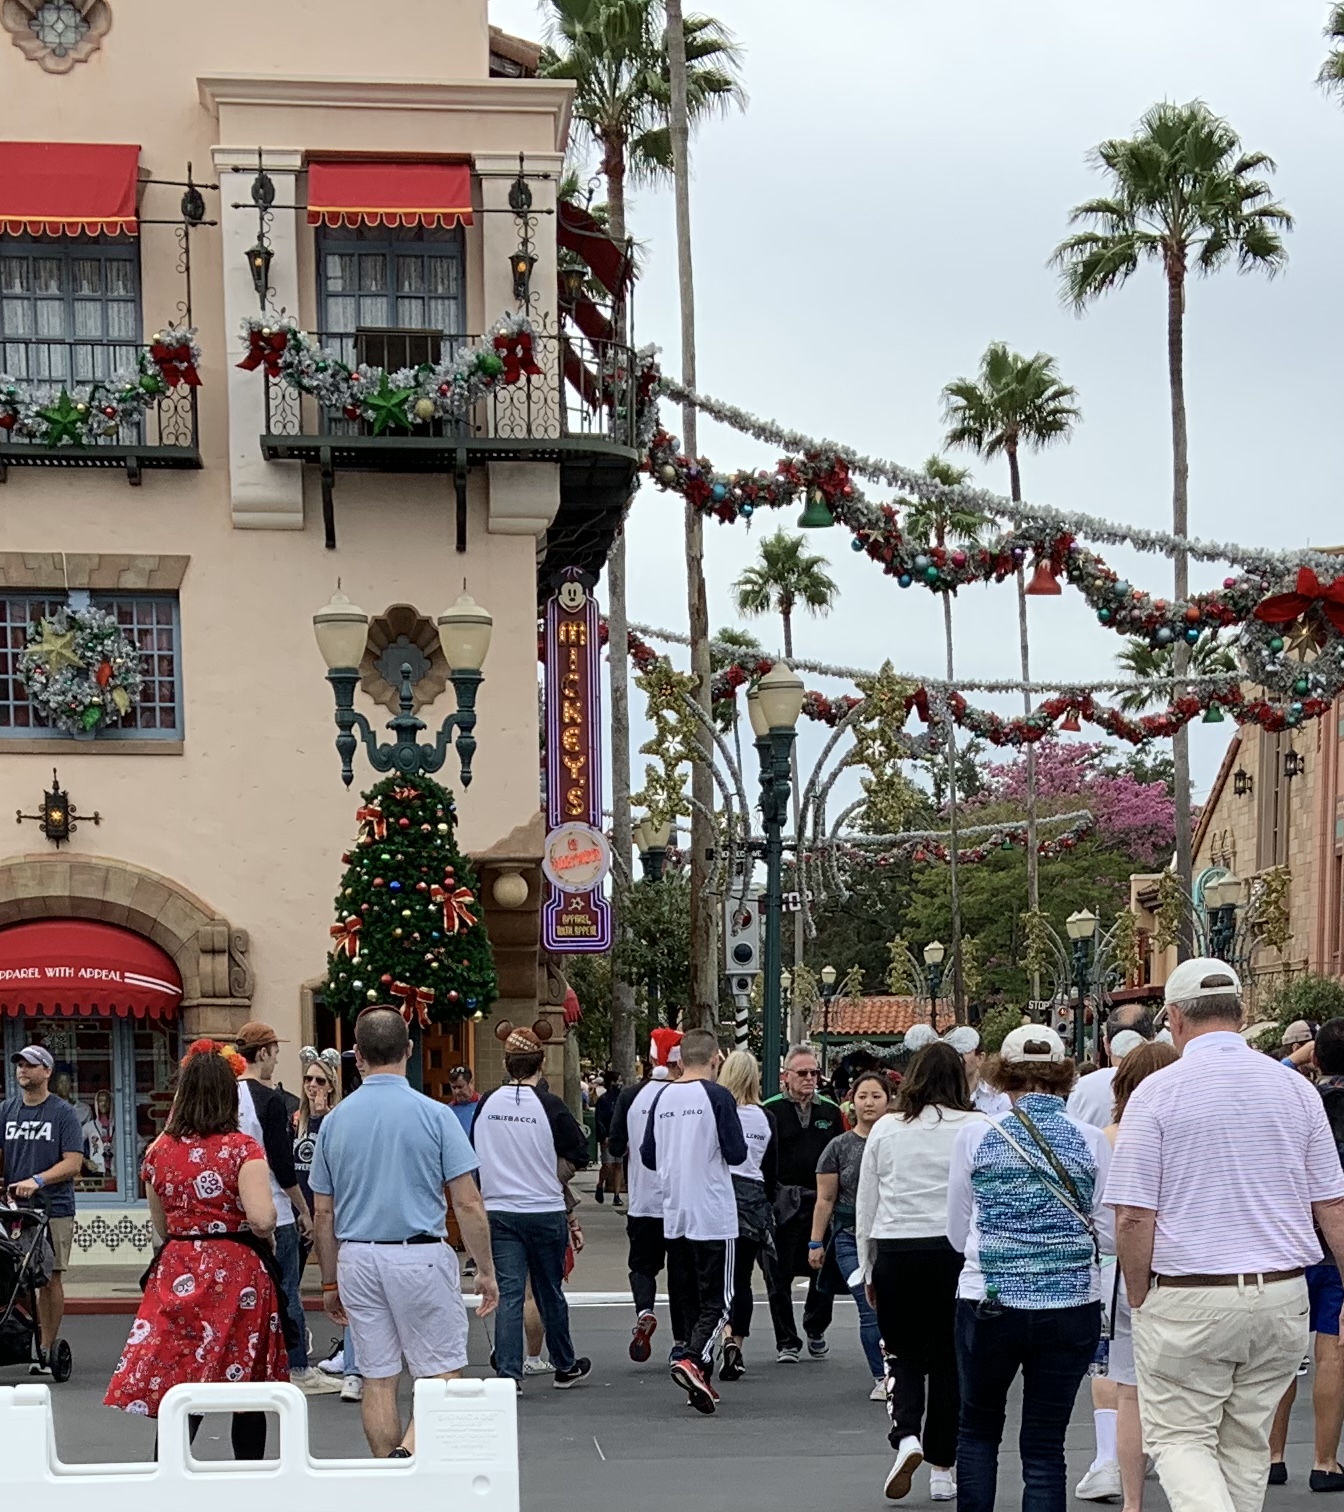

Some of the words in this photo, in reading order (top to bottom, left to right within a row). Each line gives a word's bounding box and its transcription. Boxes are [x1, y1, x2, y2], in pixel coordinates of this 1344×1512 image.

[559, 621, 586, 816] MICKEY'S
[45, 967, 75, 978] WITH
[78, 968, 123, 982] APPEAL
[1028, 1001, 1050, 1010] STOP
[6, 1121, 52, 1141] GATA
